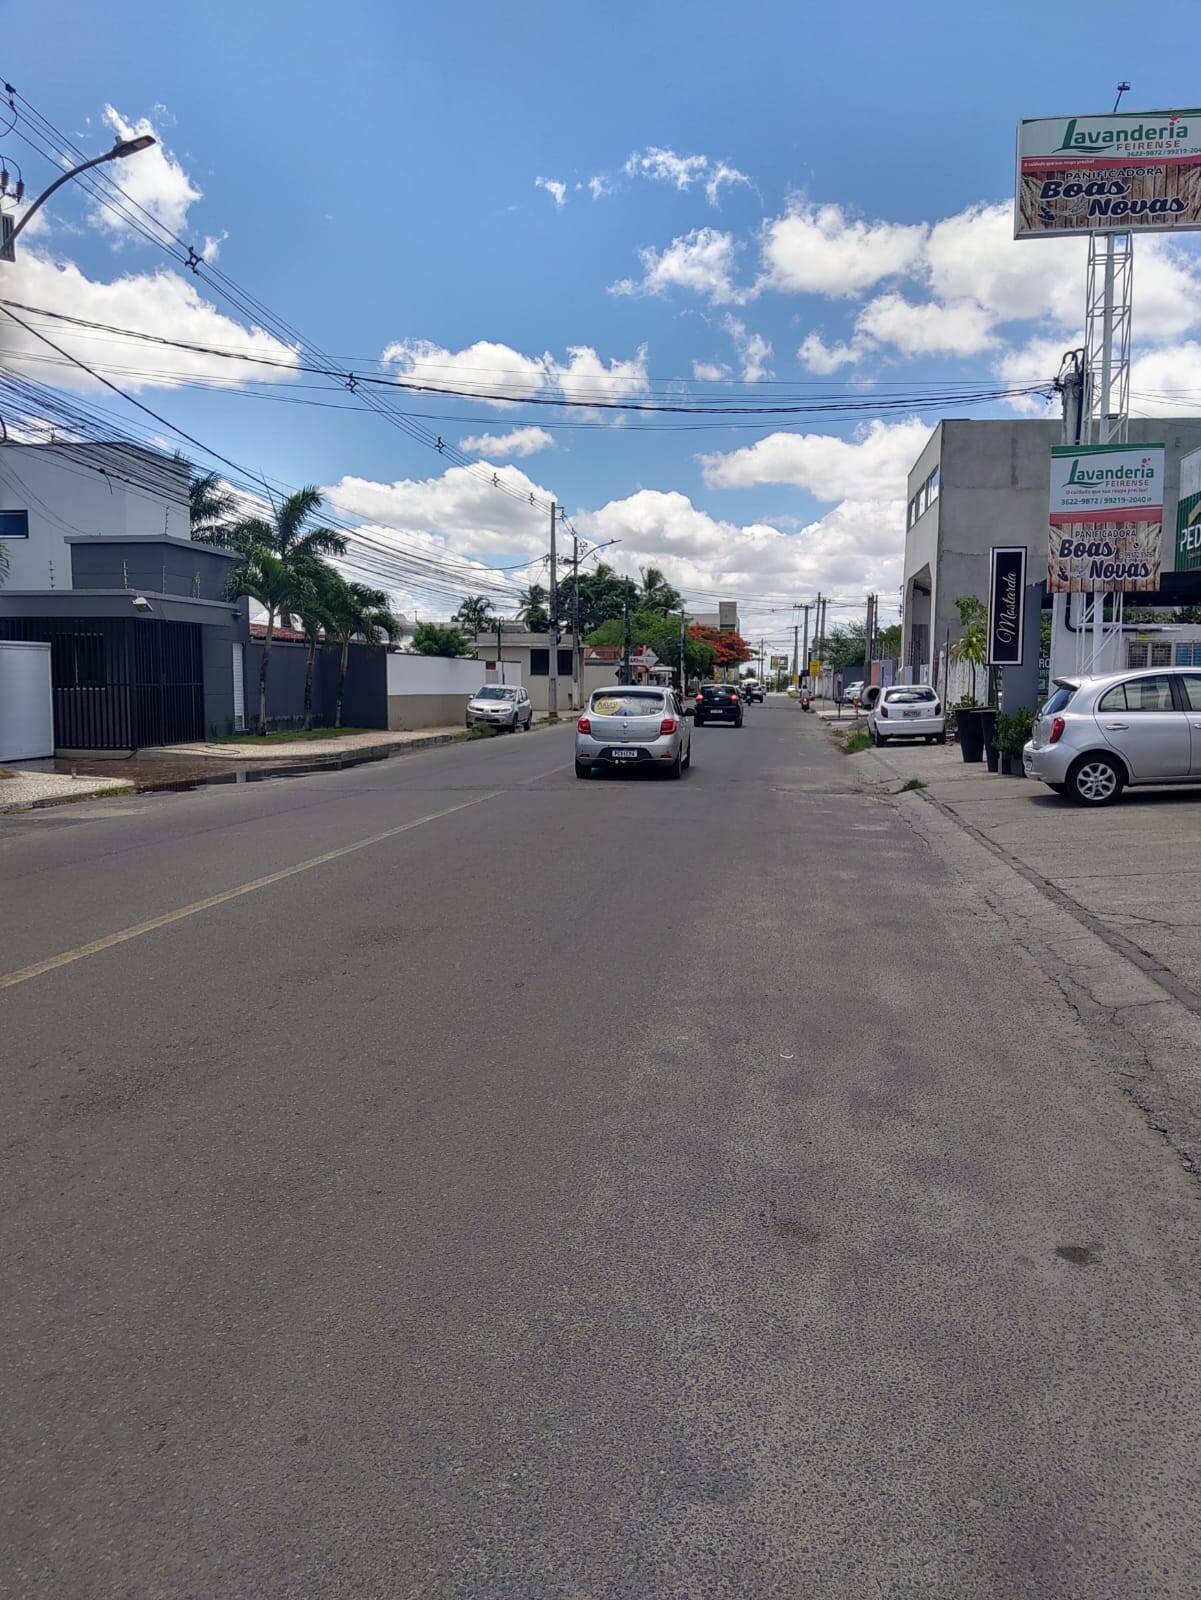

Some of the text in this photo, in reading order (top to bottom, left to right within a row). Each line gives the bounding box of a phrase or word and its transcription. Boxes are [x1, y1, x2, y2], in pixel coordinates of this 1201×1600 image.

[1062, 119, 1188, 148] Lavanderia
[1116, 140, 1181, 151] FEIRENSE
[1066, 167, 1163, 180] PANIFICADORA
[1040, 180, 1130, 199] Boas
[1088, 197, 1188, 217] Novas
[1068, 459, 1154, 484] Lavanderia
[1105, 480, 1149, 488] FEIRENSE
[1075, 529, 1136, 538] PANIFICADORA
[1059, 539, 1115, 558] Boas
[1089, 560, 1151, 579] Novas
[996, 571, 1017, 643] Mostarda
